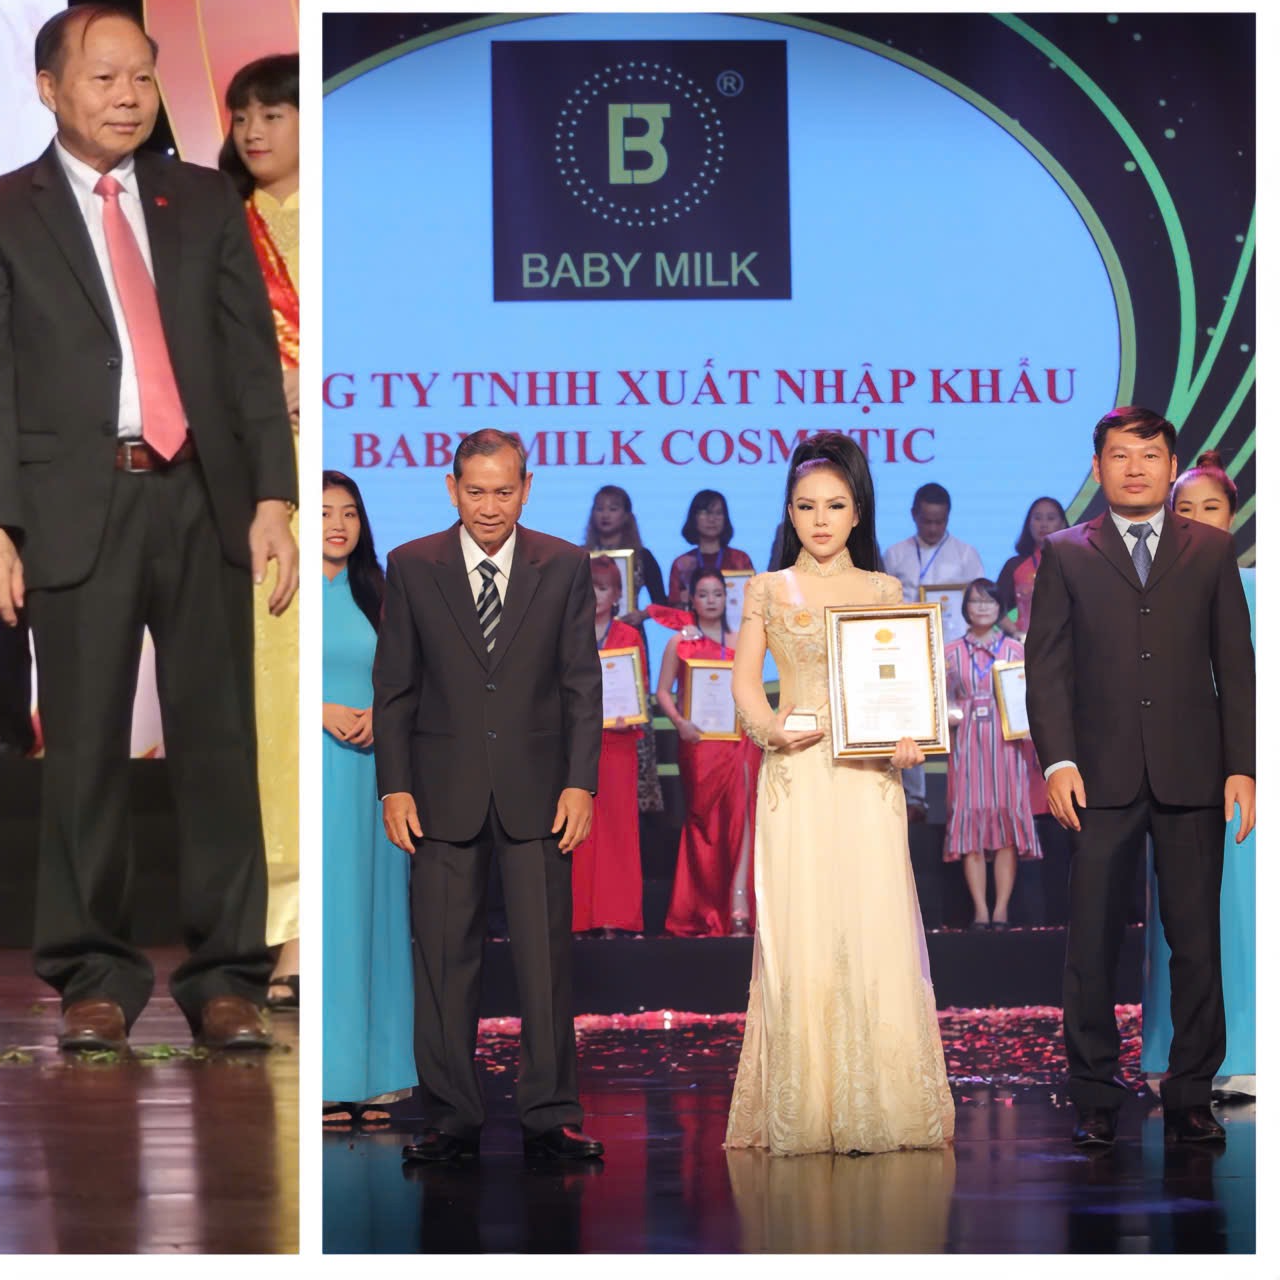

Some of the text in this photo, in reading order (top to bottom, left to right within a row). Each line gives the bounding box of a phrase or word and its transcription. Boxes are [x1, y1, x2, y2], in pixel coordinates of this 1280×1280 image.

[522, 252, 759, 287] BABY MILK
[372, 372, 439, 408] TY
[453, 370, 600, 407] TNHH
[616, 358, 759, 405] XUẤT
[775, 363, 916, 414] NHẬP
[352, 431, 470, 468] BAB
[661, 428, 935, 465] COSMTIC
